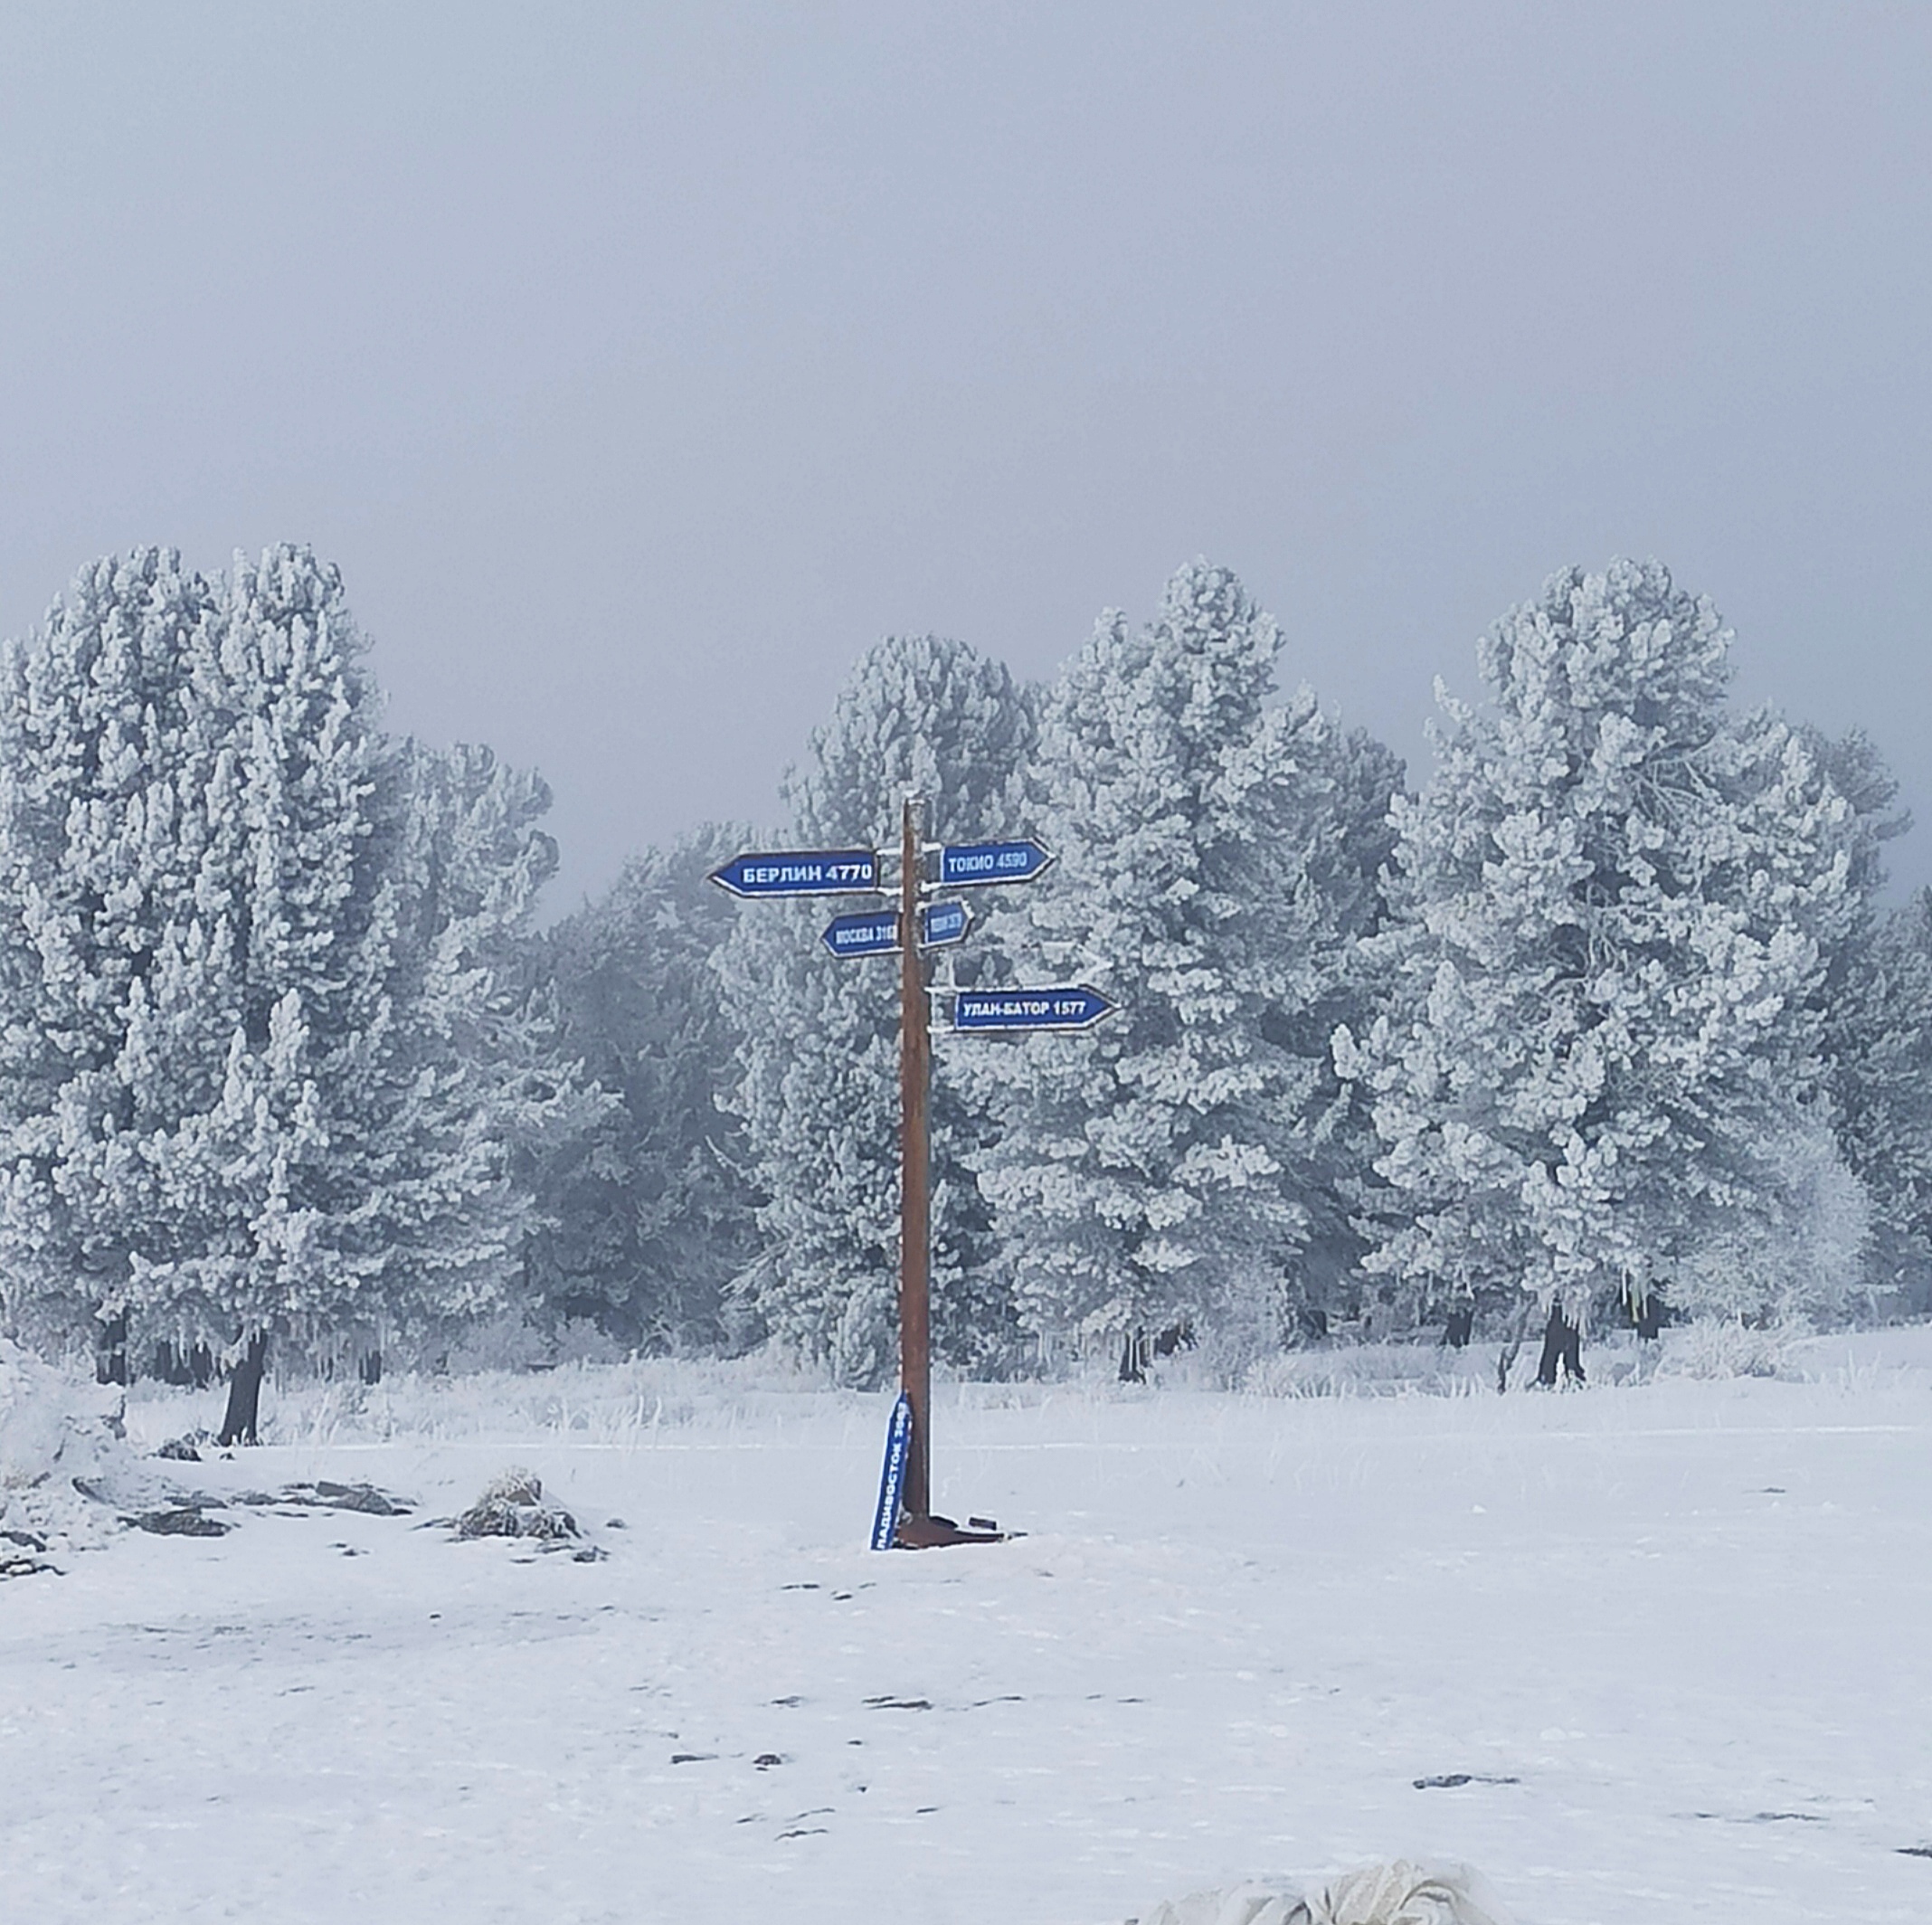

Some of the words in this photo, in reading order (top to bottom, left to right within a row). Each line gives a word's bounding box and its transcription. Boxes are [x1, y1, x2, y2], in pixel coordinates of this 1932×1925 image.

[743, 866, 821, 884] БЕРЛИН
[825, 863, 873, 881] 4770
[948, 854, 994, 873] ТОКИО
[963, 1001, 1050, 1017] УЛАН-БАТОР
[1053, 1000, 1086, 1015] 1577
[876, 1442, 903, 1549] ЛАДИВОСТОК
